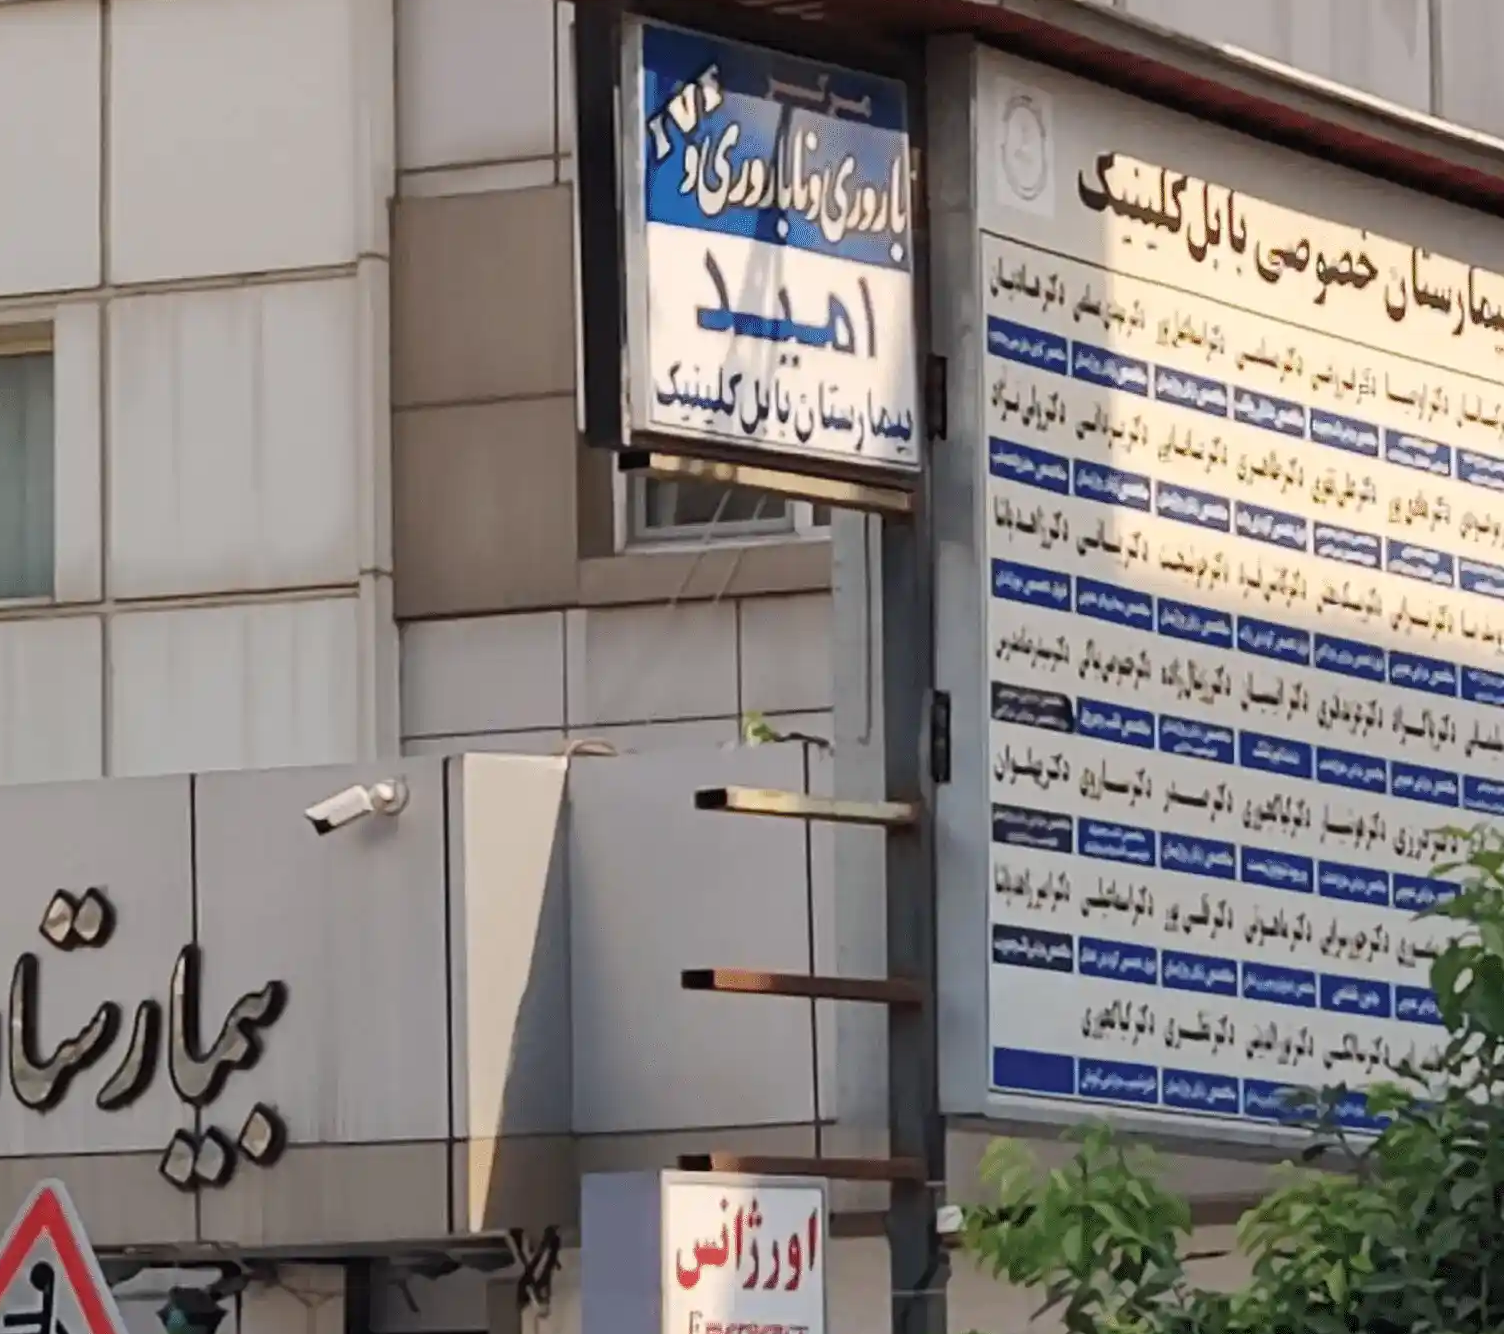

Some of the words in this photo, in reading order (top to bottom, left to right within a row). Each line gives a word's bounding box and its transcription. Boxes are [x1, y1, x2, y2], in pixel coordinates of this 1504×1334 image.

[697, 124, 817, 238] ناباروری
[821, 156, 907, 262] باروری
[1078, 151, 1188, 250] کلینیک
[1187, 183, 1247, 276] بابل
[1255, 230, 1378, 305] خصوصی
[696, 247, 877, 367] امید
[1384, 246, 1504, 354] یمارستان
[656, 361, 742, 424] کلینیک
[740, 378, 790, 437] بابل
[795, 381, 913, 452] بیمارستان
[676, 1195, 817, 1291] اورژانس
